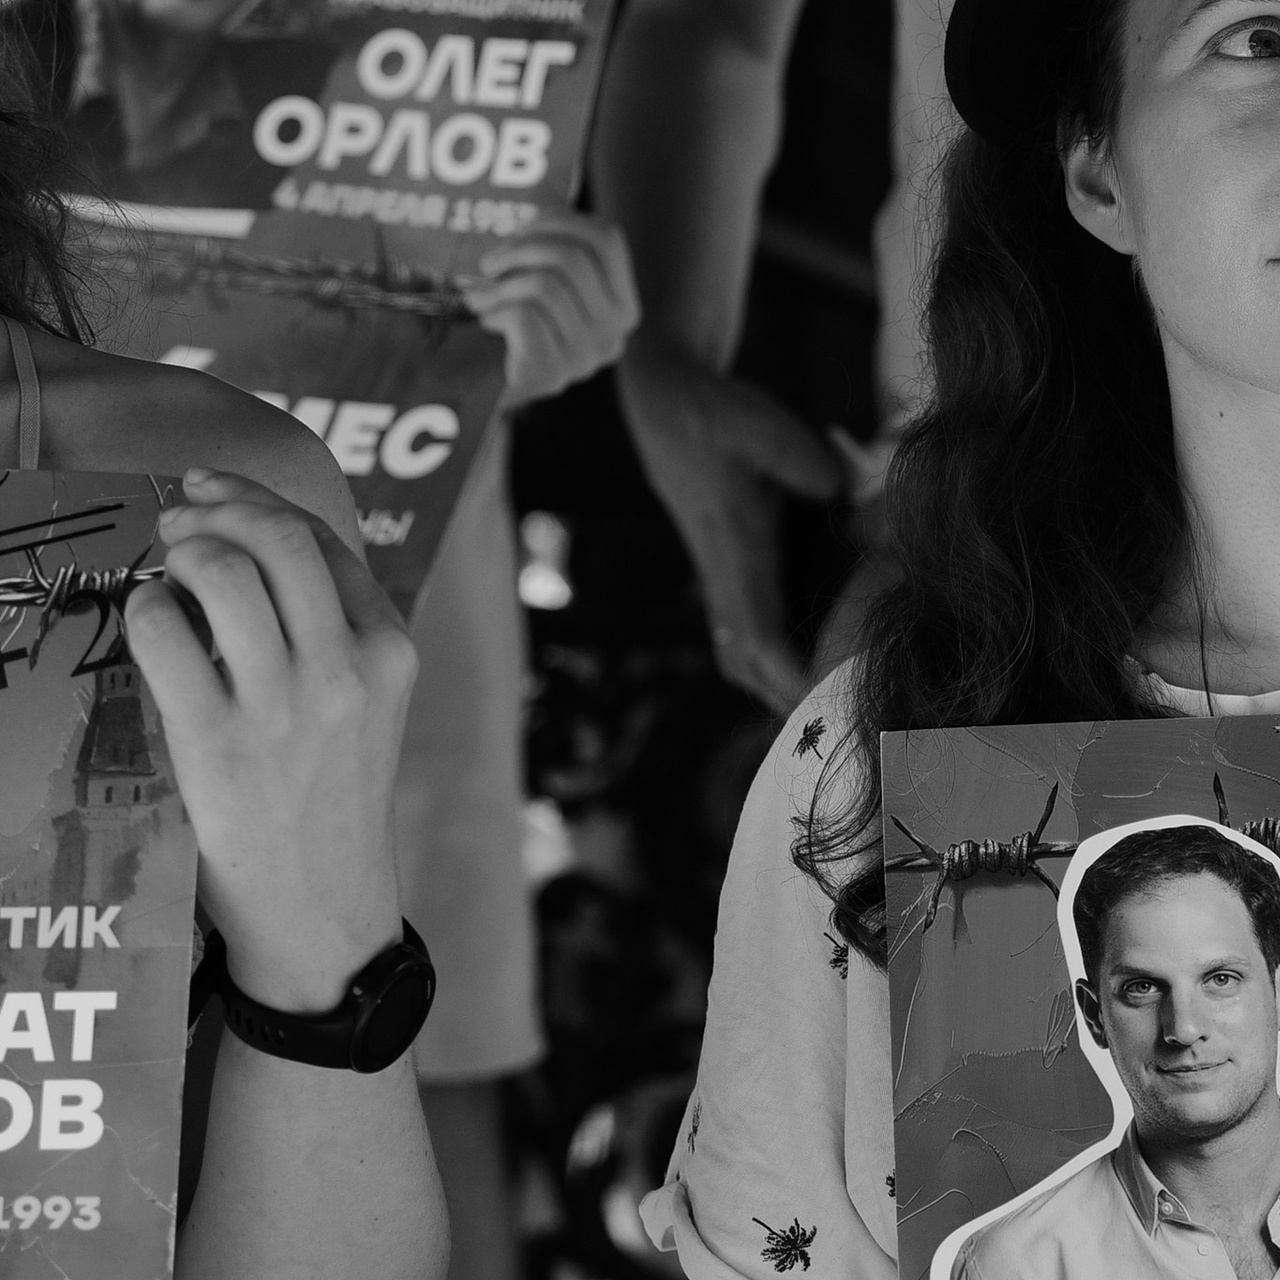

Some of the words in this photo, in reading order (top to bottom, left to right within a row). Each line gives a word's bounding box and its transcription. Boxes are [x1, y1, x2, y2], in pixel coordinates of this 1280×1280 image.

[356, 27, 577, 110] ОЛЕГ
[253, 94, 552, 189] ОРЛОВ
[0, 906, 122, 949] ТИК
